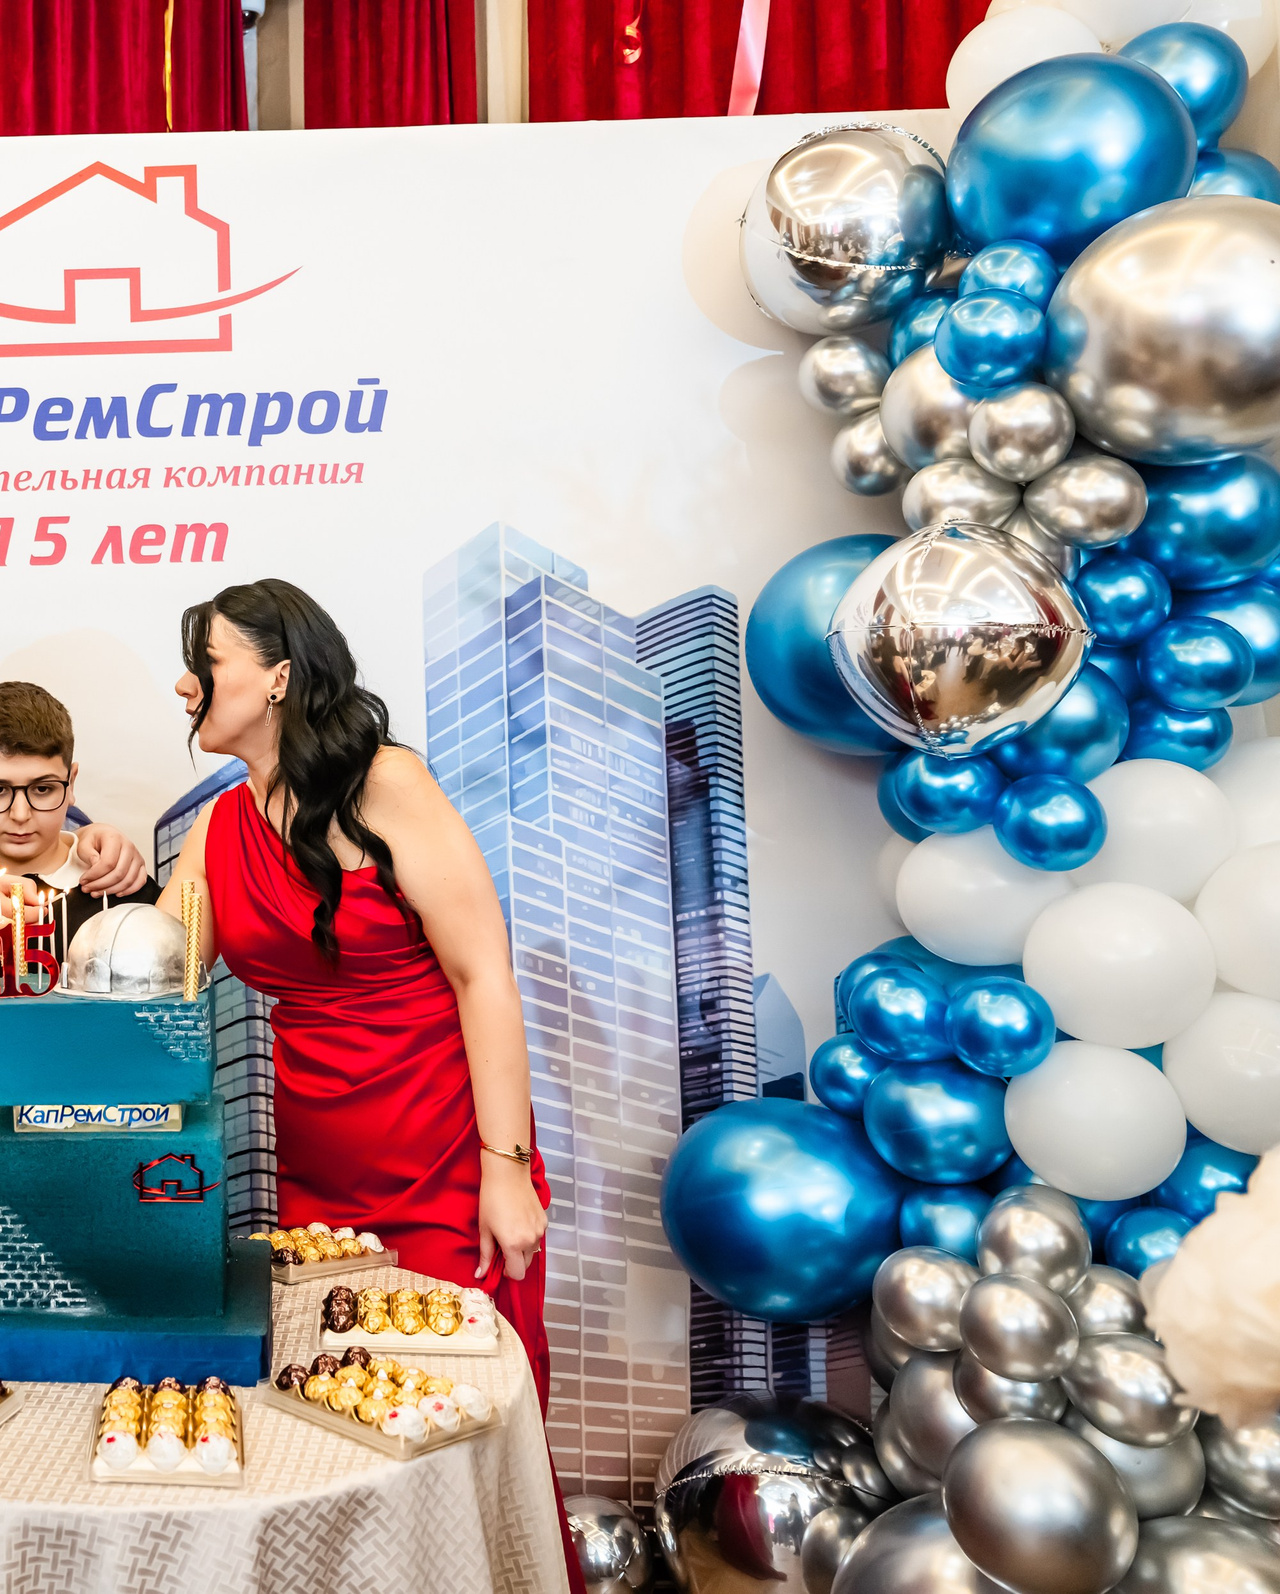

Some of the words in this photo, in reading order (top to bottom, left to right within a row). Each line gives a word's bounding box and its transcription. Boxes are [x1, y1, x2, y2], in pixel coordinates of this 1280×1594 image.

[163, 462, 365, 489] компания
[91, 522, 229, 565] лет
[18, 1104, 169, 1126] КапРемСтрой
